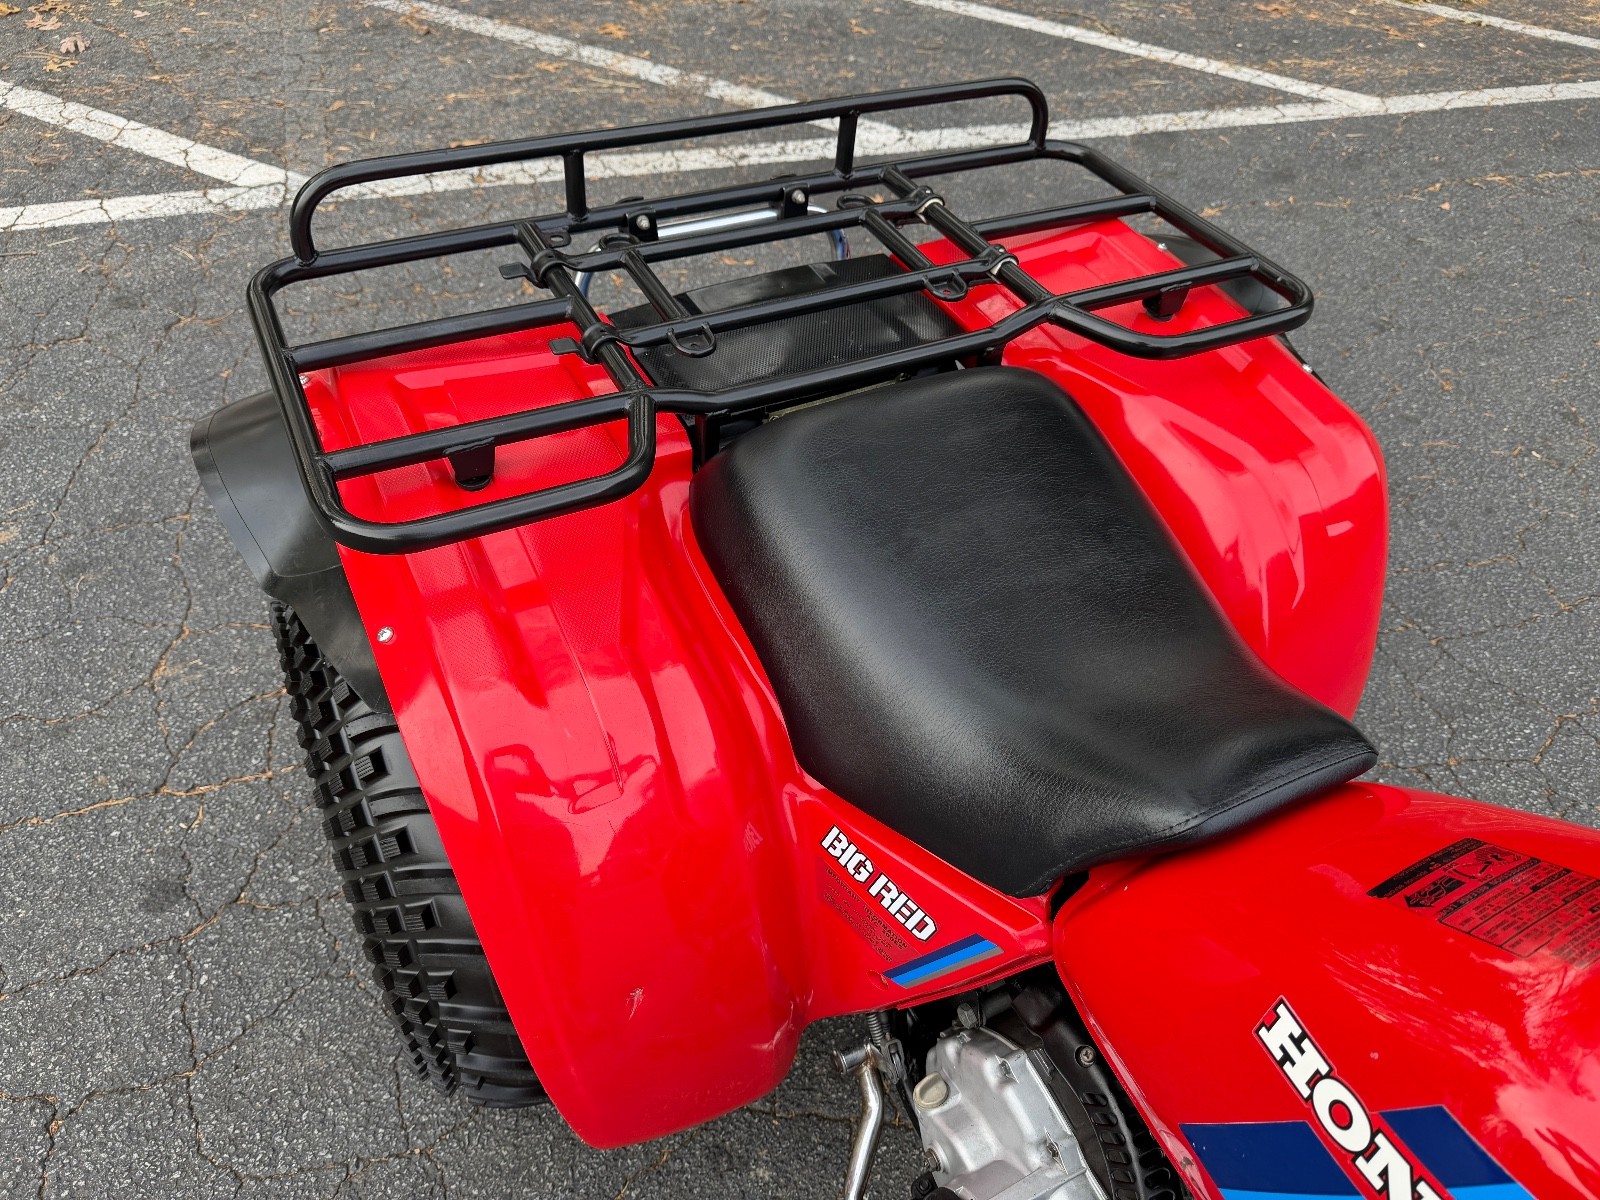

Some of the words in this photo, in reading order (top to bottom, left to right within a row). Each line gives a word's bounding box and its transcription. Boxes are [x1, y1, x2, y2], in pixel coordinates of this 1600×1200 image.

[820, 824, 875, 883] BIG
[867, 873, 938, 942] RED
[824, 867, 861, 903] IMPORTANT
[862, 904, 908, 949] INFORMATION
[865, 914, 879, 927] ATC
